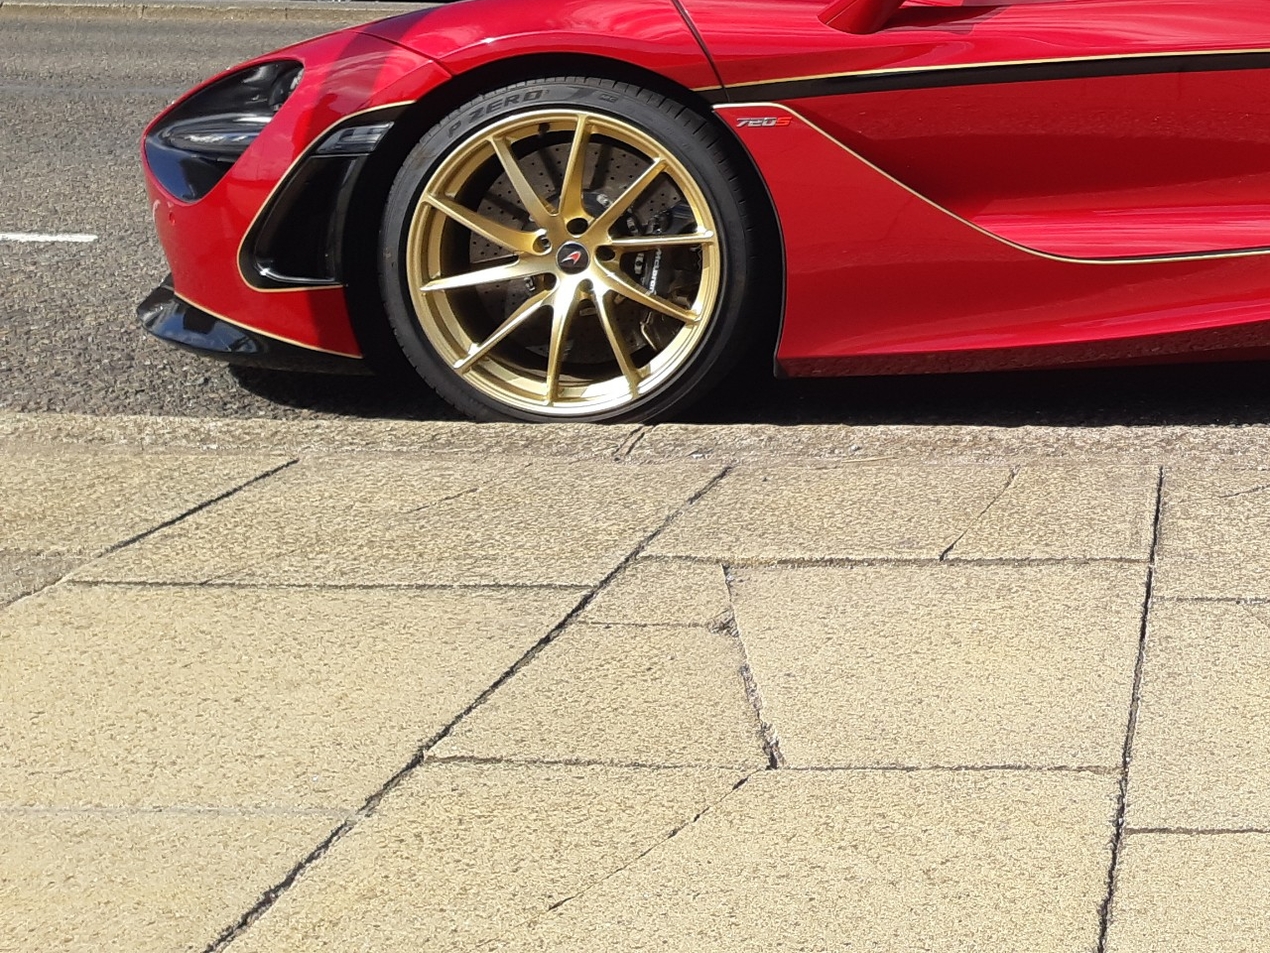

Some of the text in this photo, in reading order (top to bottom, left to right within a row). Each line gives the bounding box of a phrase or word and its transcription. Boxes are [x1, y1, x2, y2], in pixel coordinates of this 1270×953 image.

[449, 90, 545, 138] P ZERO
[736, 116, 792, 127] 720S
